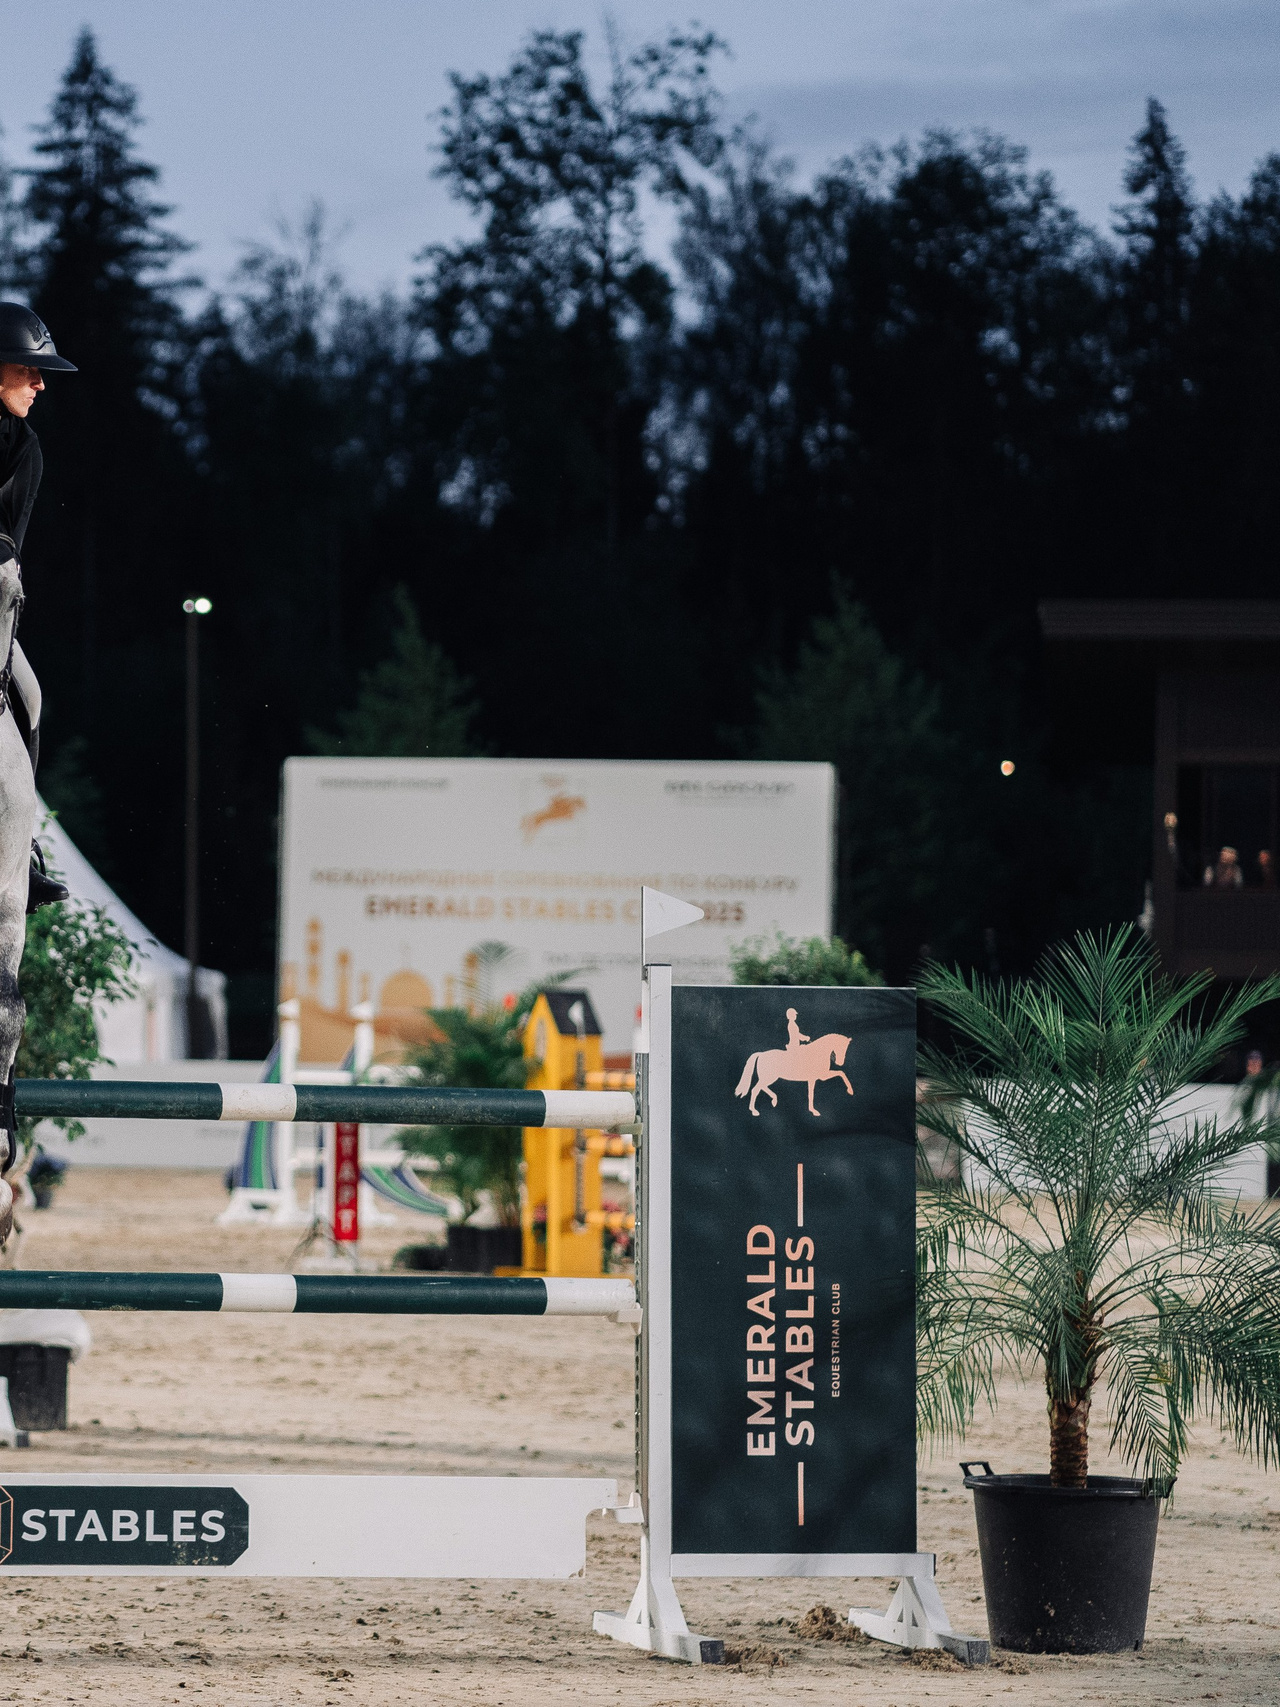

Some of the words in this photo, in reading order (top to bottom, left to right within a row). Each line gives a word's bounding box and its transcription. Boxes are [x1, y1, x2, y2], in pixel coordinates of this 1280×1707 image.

[365, 895, 495, 920] EMERALD
[502, 898, 615, 922] STABLES
[831, 1283, 841, 1314] CLUB
[746, 1224, 776, 1456] EMERALD
[785, 1236, 815, 1446] STABLES
[831, 1319, 841, 1398] EQUESTRIAN
[21, 1508, 226, 1543] STABLES
